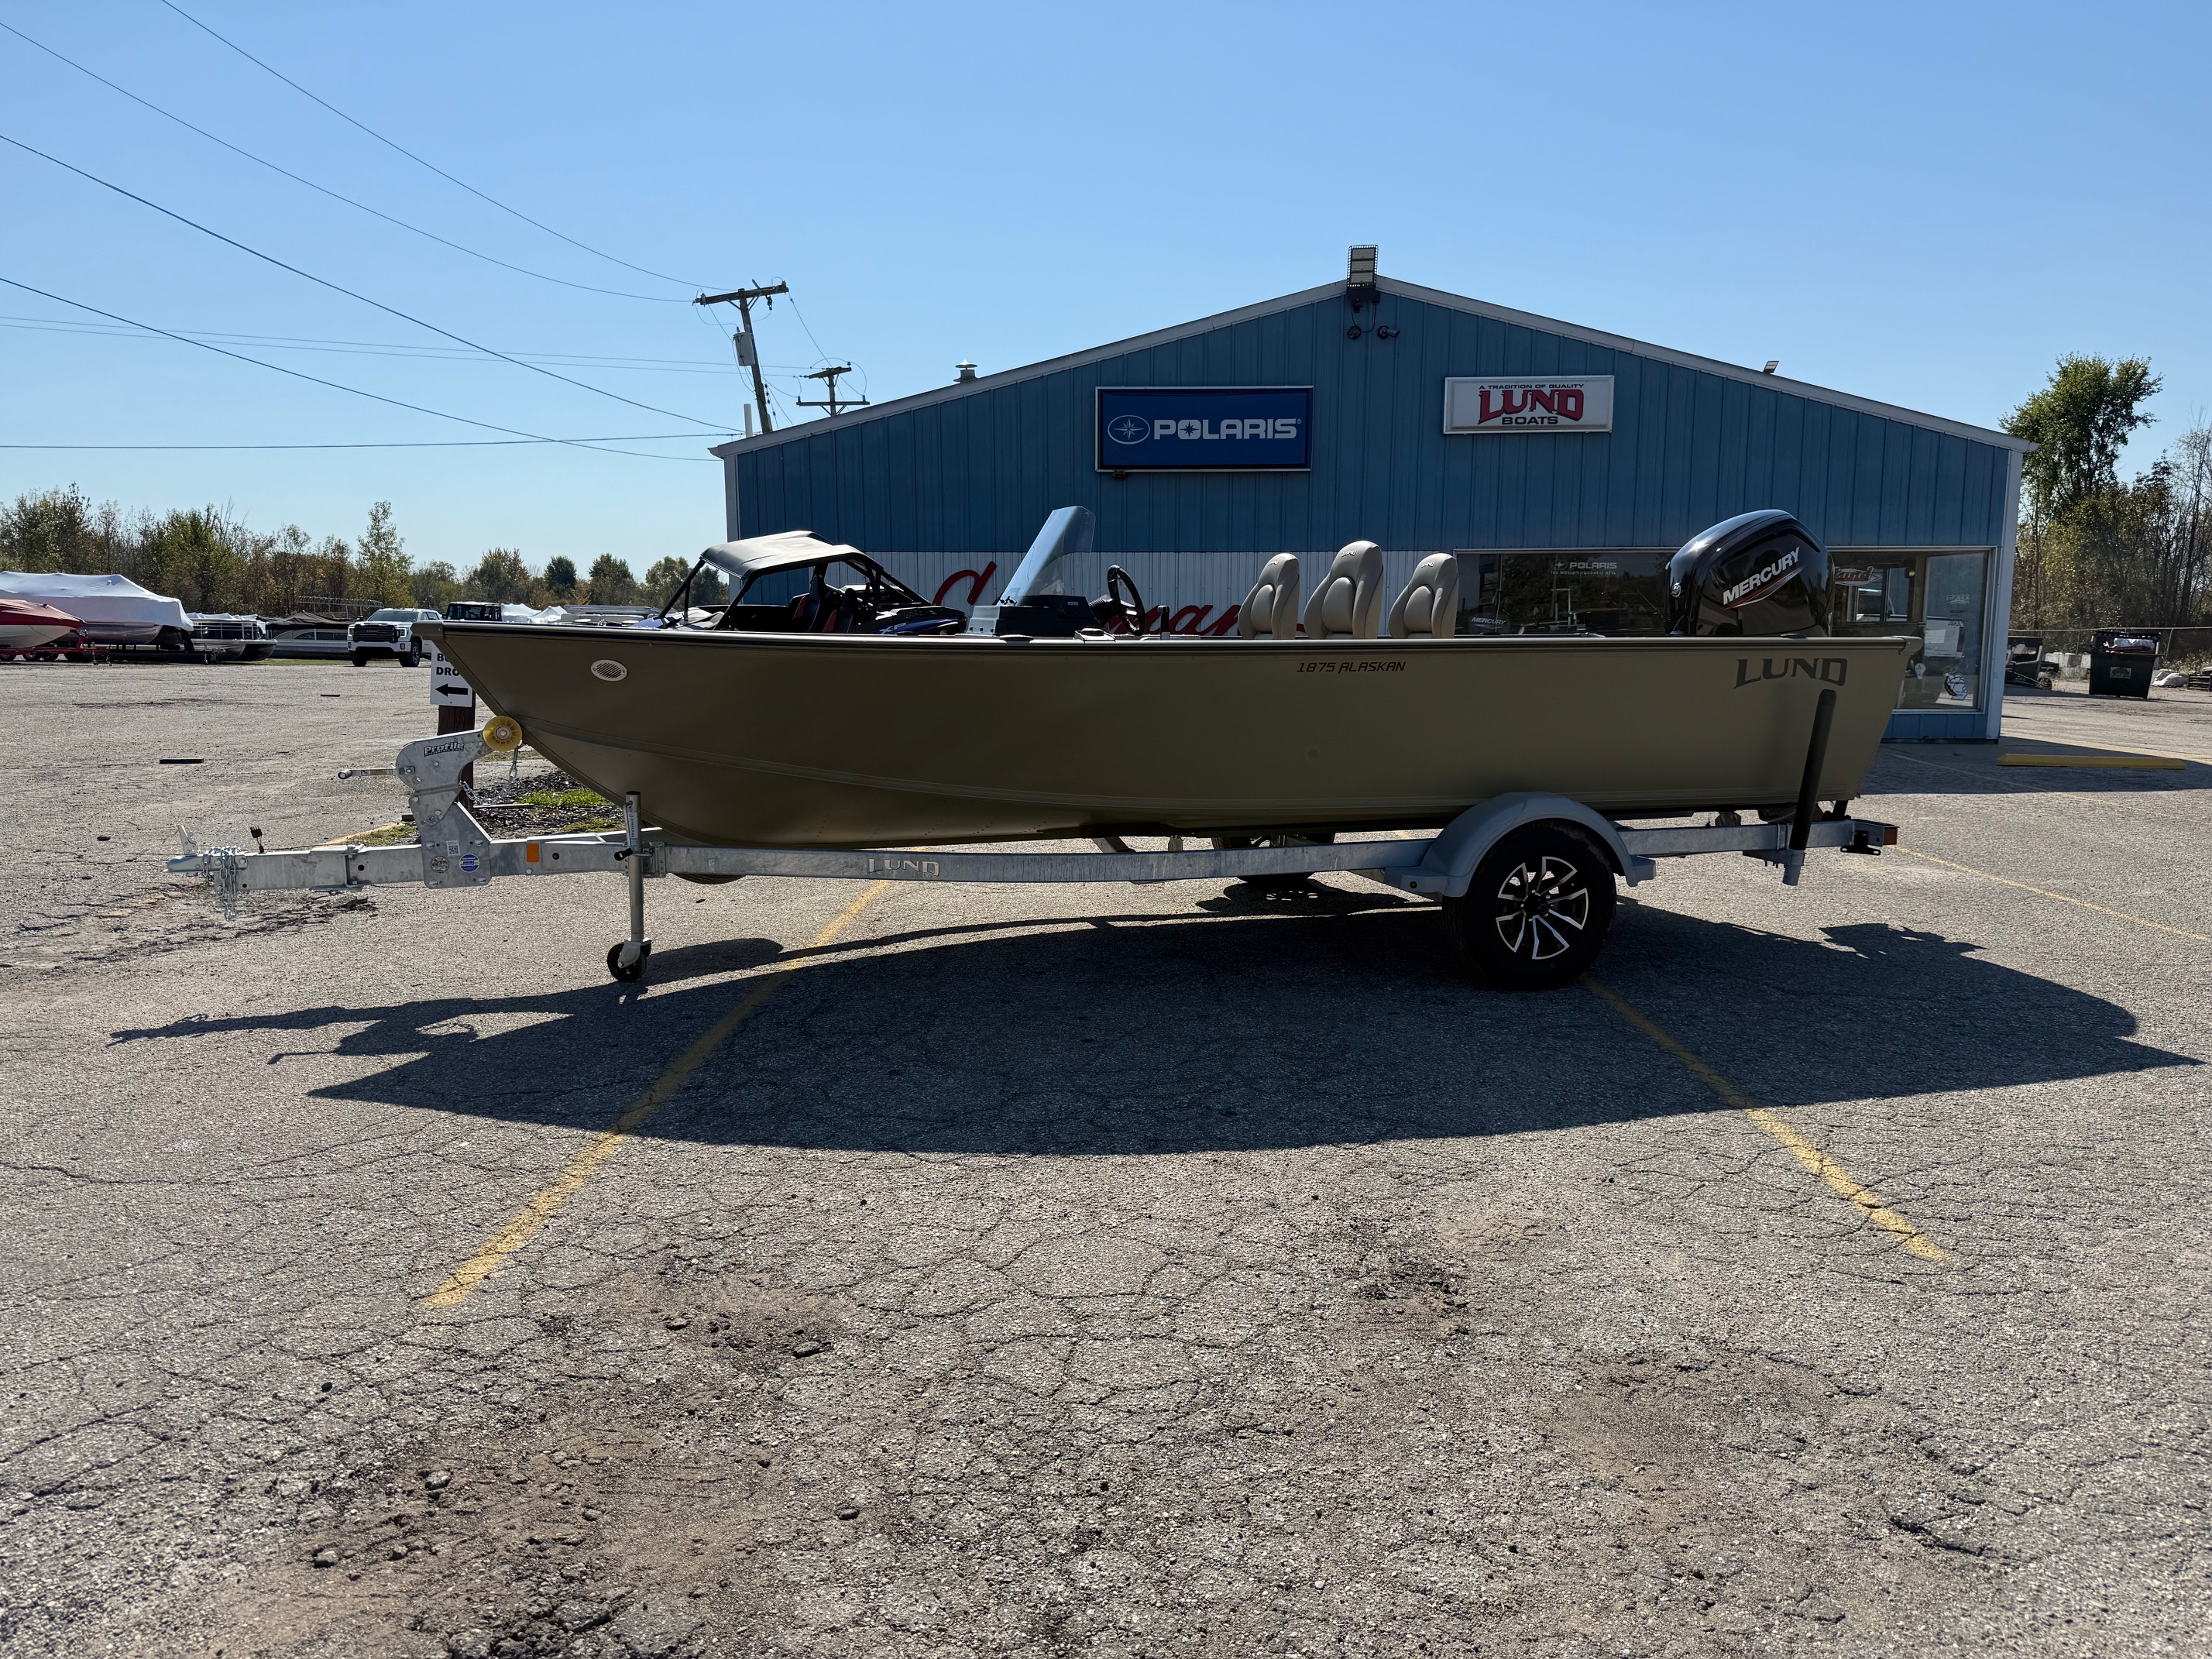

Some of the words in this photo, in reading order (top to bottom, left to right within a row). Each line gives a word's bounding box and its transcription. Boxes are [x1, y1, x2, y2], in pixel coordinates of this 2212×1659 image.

[1478, 389, 1585, 424] LUND
[1501, 416, 1558, 425] BOATS
[1723, 546, 1801, 606] MERCURY
[1471, 617, 1506, 625] MERCURY
[1297, 662, 1337, 672] 1875
[1338, 661, 1407, 675] ALASKAN
[1733, 658, 1848, 689] LUND
[424, 742, 465, 754] Profile
[868, 858, 939, 877] LUND
